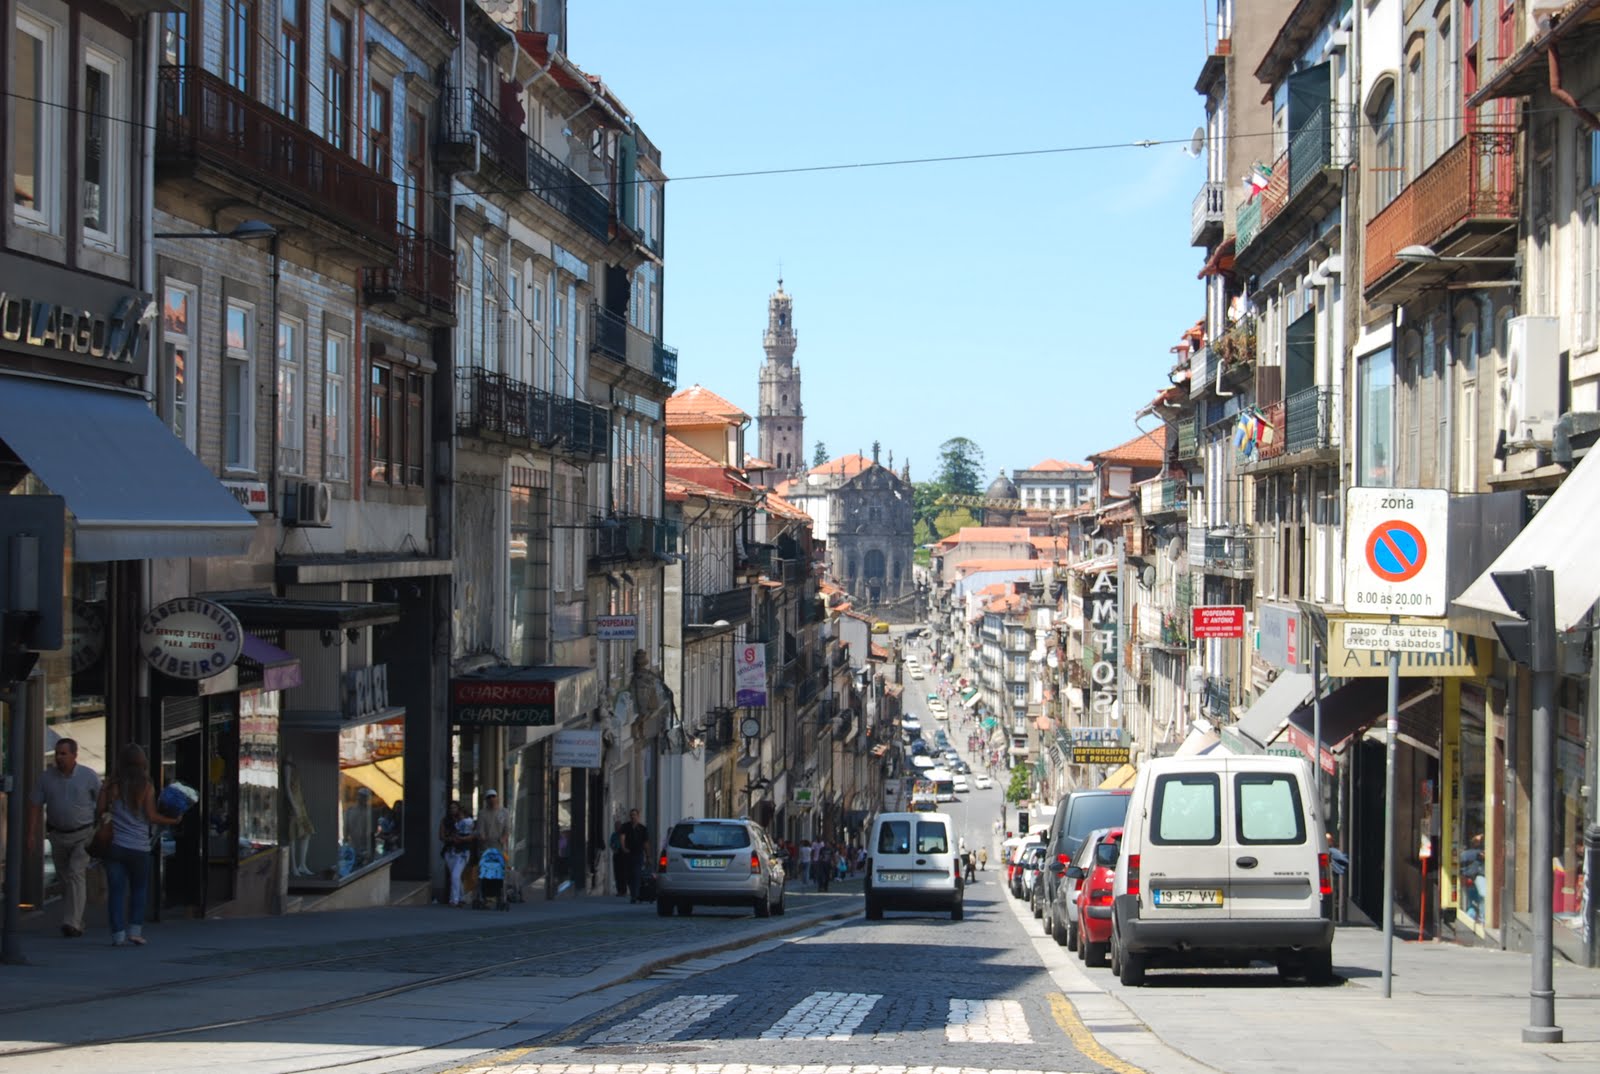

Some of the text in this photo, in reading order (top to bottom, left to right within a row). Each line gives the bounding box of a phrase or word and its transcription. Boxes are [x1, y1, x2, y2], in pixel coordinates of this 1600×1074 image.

[1381, 498, 1414, 509] zona
[1357, 591, 1378, 604] 8.00
[1395, 593, 1423, 606] 20.00
[1425, 594, 1432, 606] h
[597, 618, 634, 627] HOSPEDARIA
[187, 630, 222, 640] ESPECIAL
[1350, 623, 1437, 638] pago dias úteis
[164, 640, 216, 650] PARA JOVENS
[1347, 636, 1441, 648] excepto sábados
[149, 646, 226, 677] RIBEIRO
[459, 685, 550, 700] CHARMODA
[459, 707, 550, 722] CHARMODA
